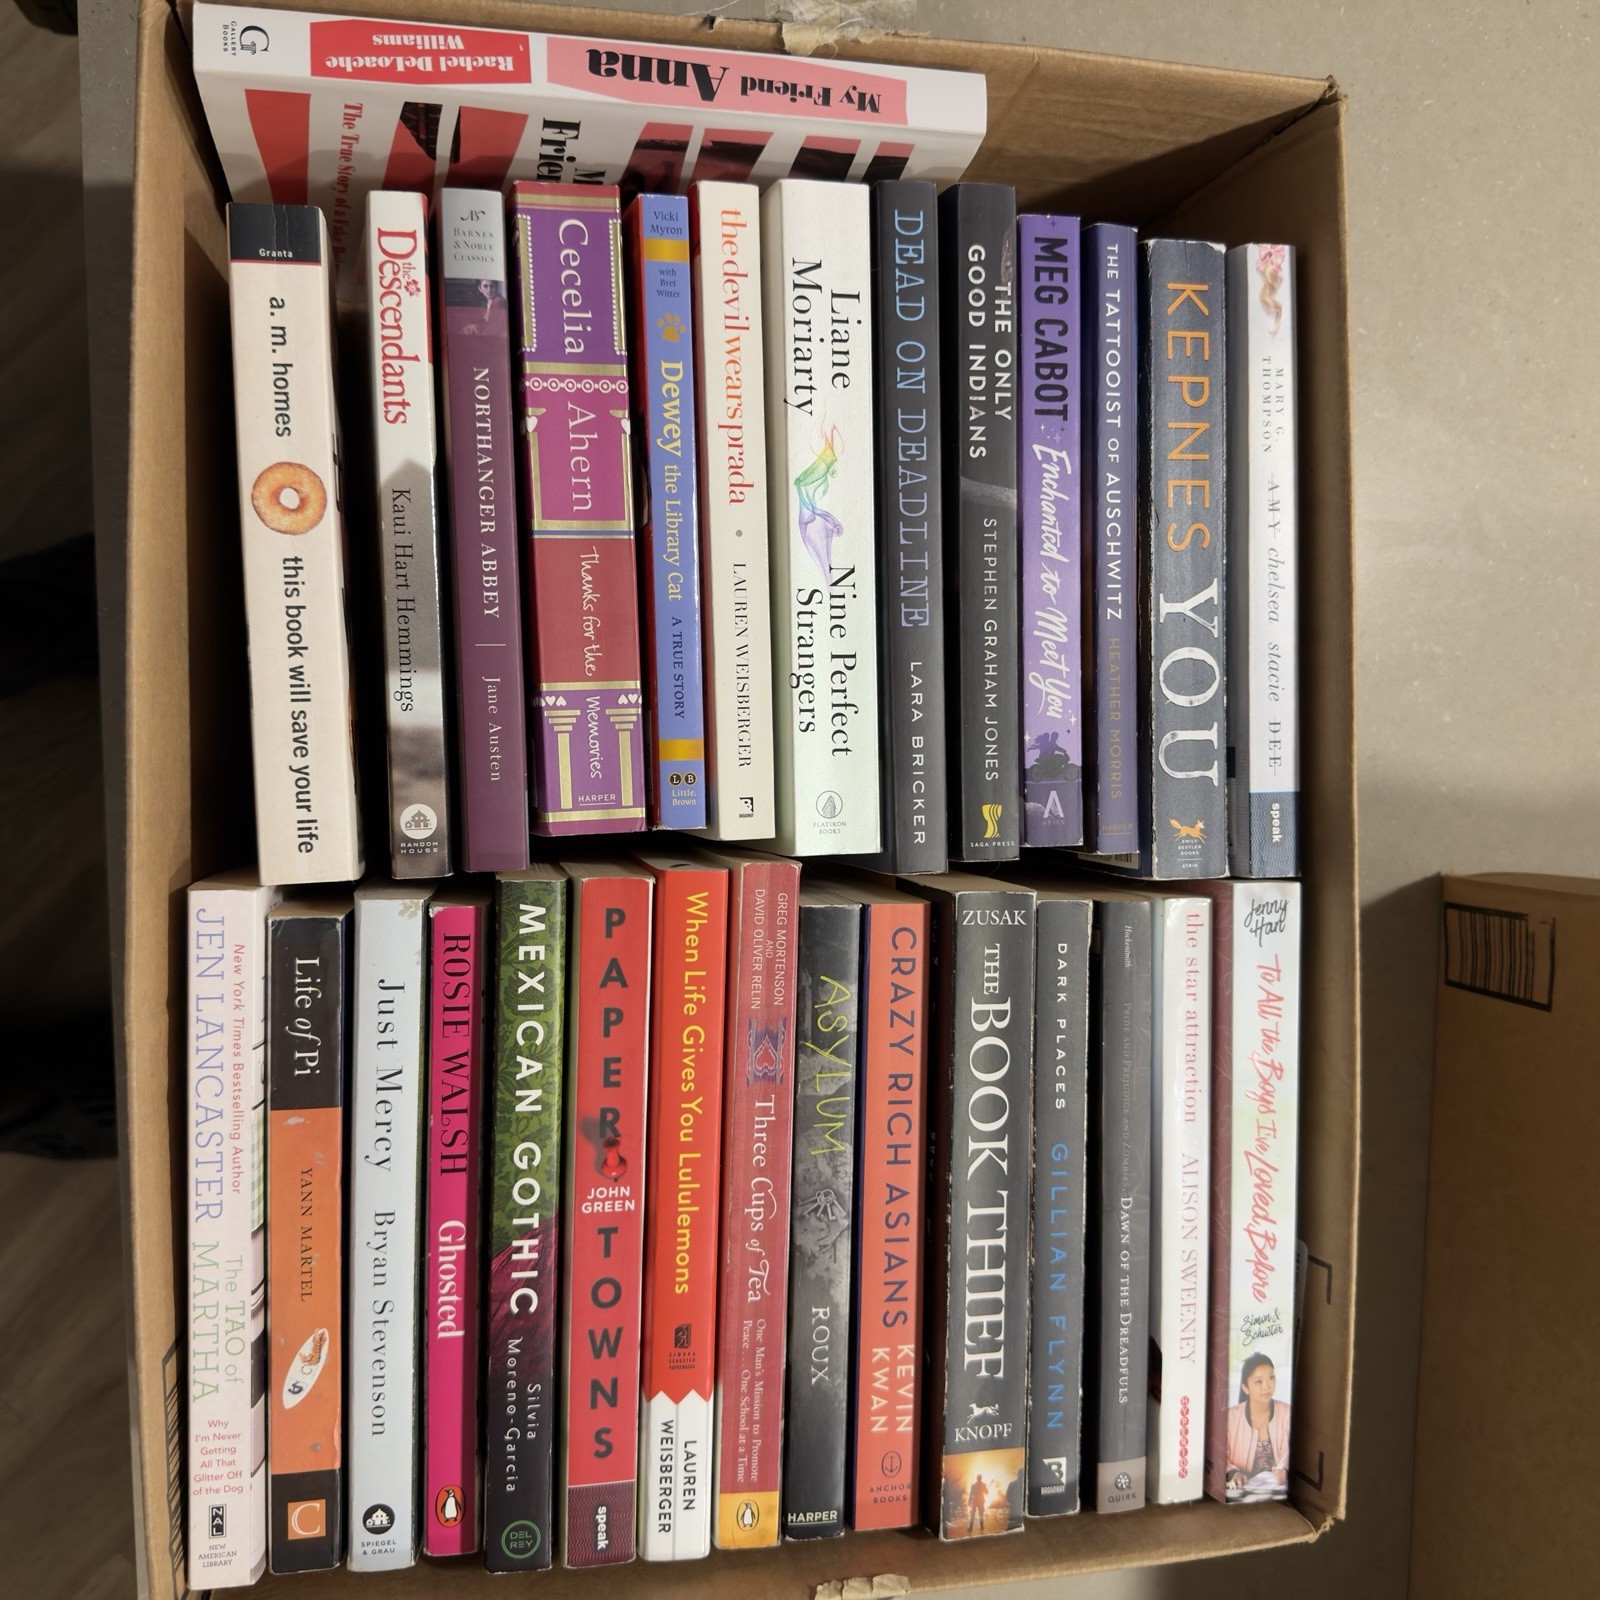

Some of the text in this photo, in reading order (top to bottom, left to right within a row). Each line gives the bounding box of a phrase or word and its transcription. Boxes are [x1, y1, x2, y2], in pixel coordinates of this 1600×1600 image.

[325, 55, 514, 72] Rachel DeLoache
[372, 34, 465, 50] Williams
[586, 49, 882, 114] My Friend Anna
[259, 248, 293, 258] Granta
[650, 224, 683, 238] Myron
[653, 211, 679, 222] Vicki
[659, 268, 677, 277] with
[377, 227, 421, 425] Descendants
[656, 289, 681, 298] Witter
[660, 279, 676, 287] Bret
[783, 257, 825, 417] Moriarty
[830, 289, 862, 389] Liane
[1034, 236, 1069, 421] MEG CABOT
[558, 218, 598, 512] Cecelia Ahern
[968, 244, 986, 459] GOOD INDIANS
[994, 281, 1012, 421] THE ONLY
[894, 209, 930, 627] DEAD ON DEADLINE
[1106, 243, 1122, 620] THE TATTOOIST OF AUSCHWITZ
[473, 367, 499, 619] NORTHANGER ABBEY
[657, 360, 684, 603] Dewey the Library Cat
[1158, 282, 1220, 787] KEPNES YOU
[392, 488, 416, 713] Kaui Hart Hemmings
[788, 588, 824, 733] Strangers
[828, 564, 859, 757] Nine Perfect
[983, 518, 999, 781] STEPHEN GRAHAM JONES
[282, 556, 319, 854] this book will save your life
[733, 563, 752, 768] LAUREN WEISBERGER
[1108, 637, 1122, 799] HEATHER MORRIS
[481, 676, 502, 782] Jane Austen
[910, 661, 925, 844] LARA BRICKER
[578, 793, 616, 803] HARPER
[1271, 803, 1280, 843] speak
[751, 889, 766, 1009] DAVID OLIVER RELIN
[773, 893, 788, 1006] GREG MORTENSON
[962, 910, 1027, 926] ZUSAK
[195, 908, 225, 1223] JEN LANCASTER
[230, 943, 245, 1194] New York Times Bestselling Author
[285, 957, 322, 1077] Life of Pi
[805, 975, 852, 1155] ASYLUM
[1055, 943, 1068, 1109] DARK PLACES
[1184, 912, 1204, 1123] the star attraction
[437, 933, 471, 1339] ROSIE WALSH Ghosted
[509, 903, 547, 1315] MEXICAN GOTHIC
[675, 891, 709, 1294] When Life Gives You Lululemons
[882, 926, 917, 1328] CRAZY RICH ASIANS
[364, 978, 406, 1437] Just Mercy Bryan Stevenson
[581, 1199, 635, 1214] GREEN
[587, 1186, 630, 1200] JOHN
[744, 1094, 777, 1303] Three Cups of Tea
[964, 943, 1011, 1378] THE BOOK THIEF
[300, 1167, 313, 1302] YANN MARTEL
[1047, 1143, 1069, 1429] GILLIAN FLYNN
[1179, 1153, 1199, 1363] ALISON SWEENEY
[192, 1241, 220, 1402] MARTHA
[225, 1255, 245, 1383] The TAO of
[811, 1306, 830, 1386] ROUX
[1119, 1196, 1133, 1403] DAWN OF THE DREADFULS
[195, 1432, 242, 1442] I'm Never
[207, 1420, 229, 1429] Why
[504, 1337, 523, 1492] Moreno-Garcia
[527, 1382, 541, 1439] Silvia
[870, 1347, 891, 1432] KWAN
[895, 1344, 915, 1432] KEVIN
[954, 1423, 1013, 1442] KNOPF
[192, 1484, 244, 1496] of the Dog
[194, 1470, 243, 1482] Glitter Off
[200, 1446, 237, 1456] Getting
[201, 1459, 236, 1469] All That
[658, 1419, 674, 1534] WEISBERGER
[682, 1440, 697, 1511] LAUREN
[869, 1483, 912, 1493] ANCHOR
[873, 1494, 907, 1504] BOOKS
[1041, 1485, 1066, 1495] BROADWAY
[1108, 1492, 1137, 1503] QUIRK
[595, 1506, 609, 1550] speak
[787, 1510, 838, 1523] HARPER
